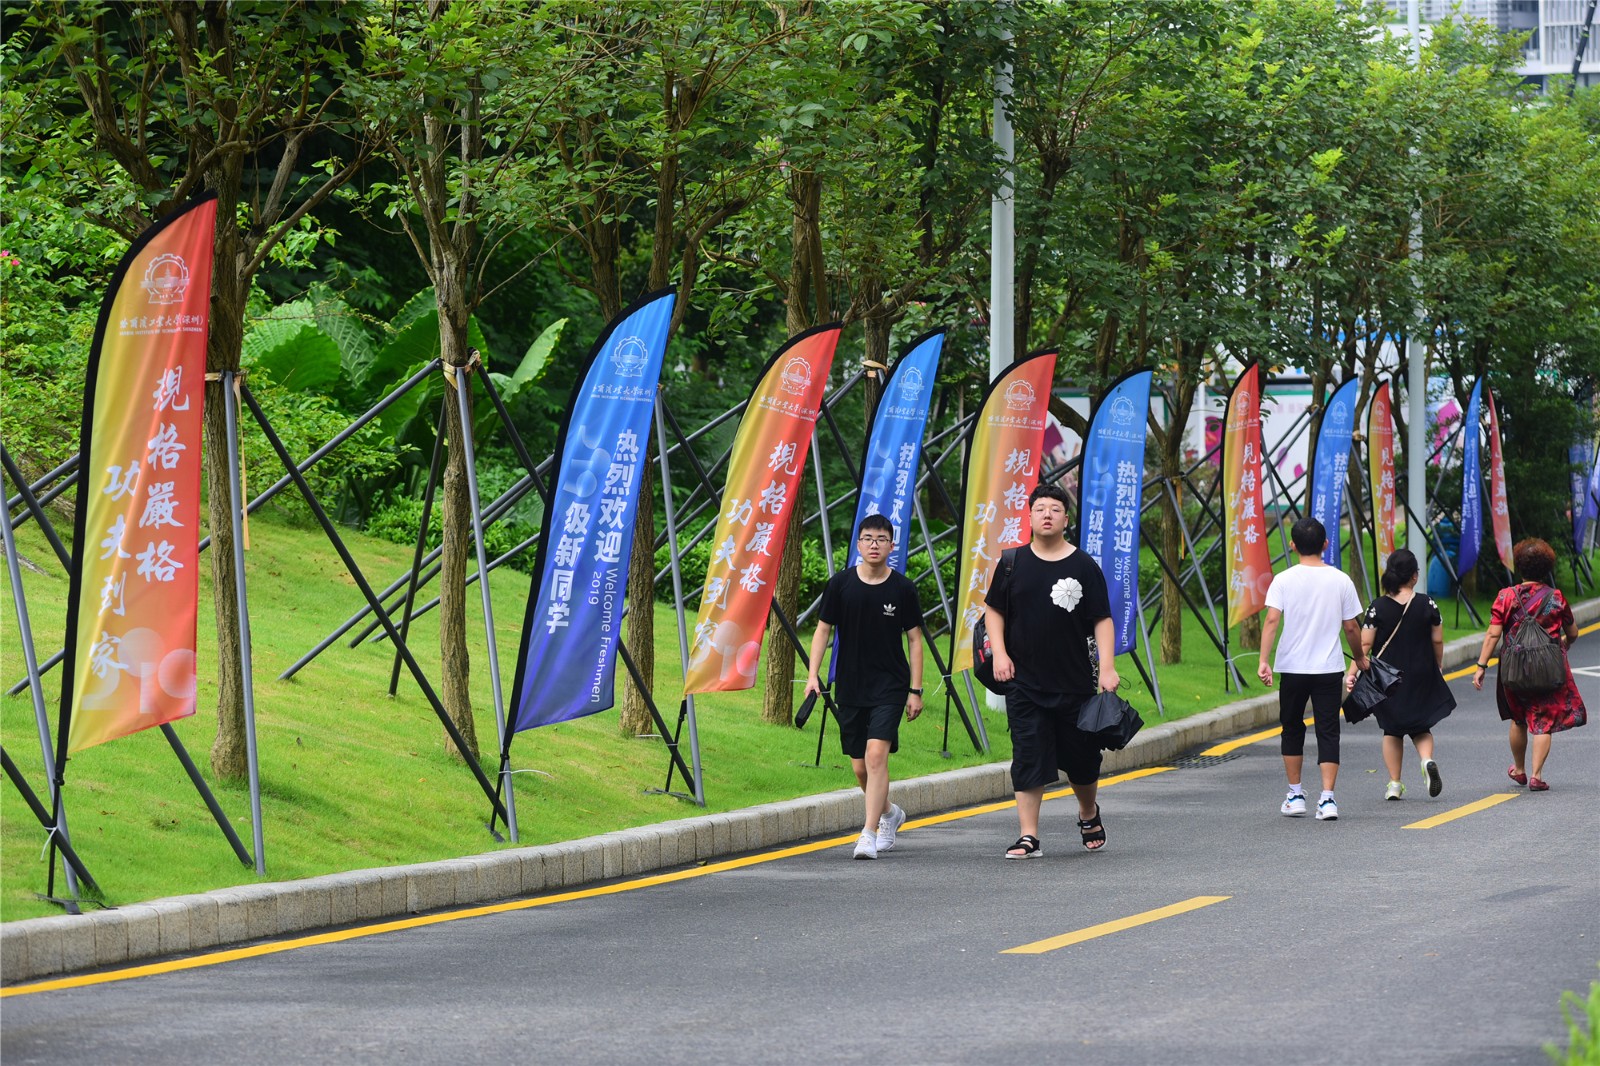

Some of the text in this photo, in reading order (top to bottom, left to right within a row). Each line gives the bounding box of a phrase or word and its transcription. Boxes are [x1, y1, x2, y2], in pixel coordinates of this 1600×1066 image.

[594, 428, 640, 564] 热烈欢迎
[1113, 460, 1138, 553] 热烈欢迎
[89, 459, 142, 680] 功夫到家
[588, 571, 602, 605] 2019
[694, 498, 753, 650] 功夫到家
[1114, 557, 1123, 581] 2019
[1122, 555, 1134, 647] Welcome Freshmen
[591, 567, 619, 703] Welcome Freshmen
